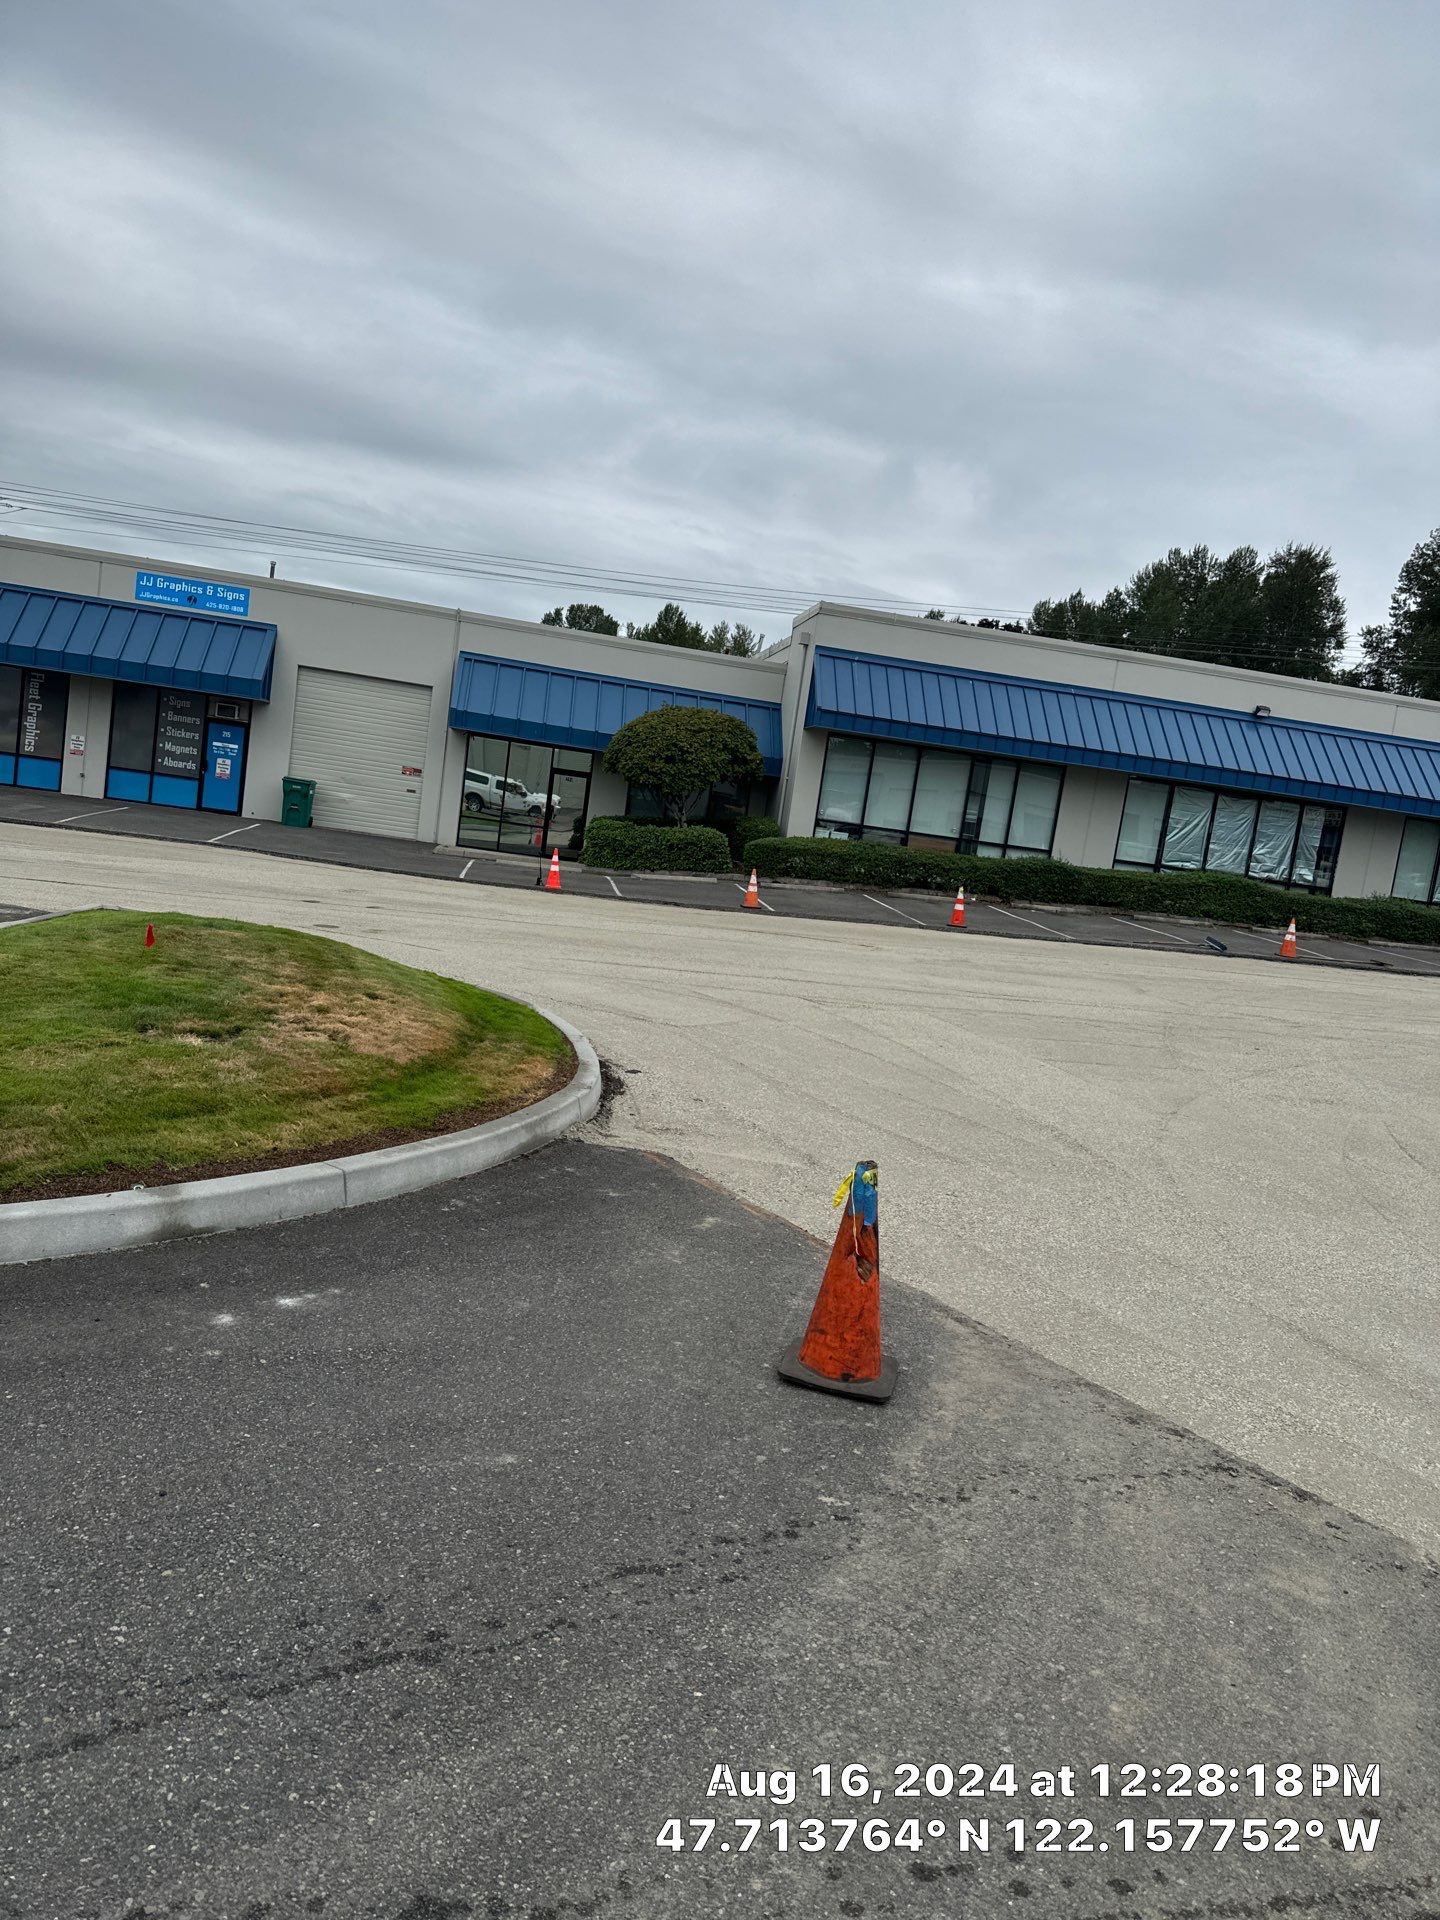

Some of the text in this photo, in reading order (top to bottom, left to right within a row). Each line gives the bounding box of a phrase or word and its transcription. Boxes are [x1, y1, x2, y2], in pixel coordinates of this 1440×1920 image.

[139, 575, 245, 601] JJ Graphics & Signs
[168, 696, 191, 709] Signs
[23, 671, 45, 752] Fleet Graphics
[167, 710, 200, 725] Banners
[165, 726, 199, 740] Stickers
[164, 741, 198, 755] Magnets
[163, 756, 197, 770] Aboards
